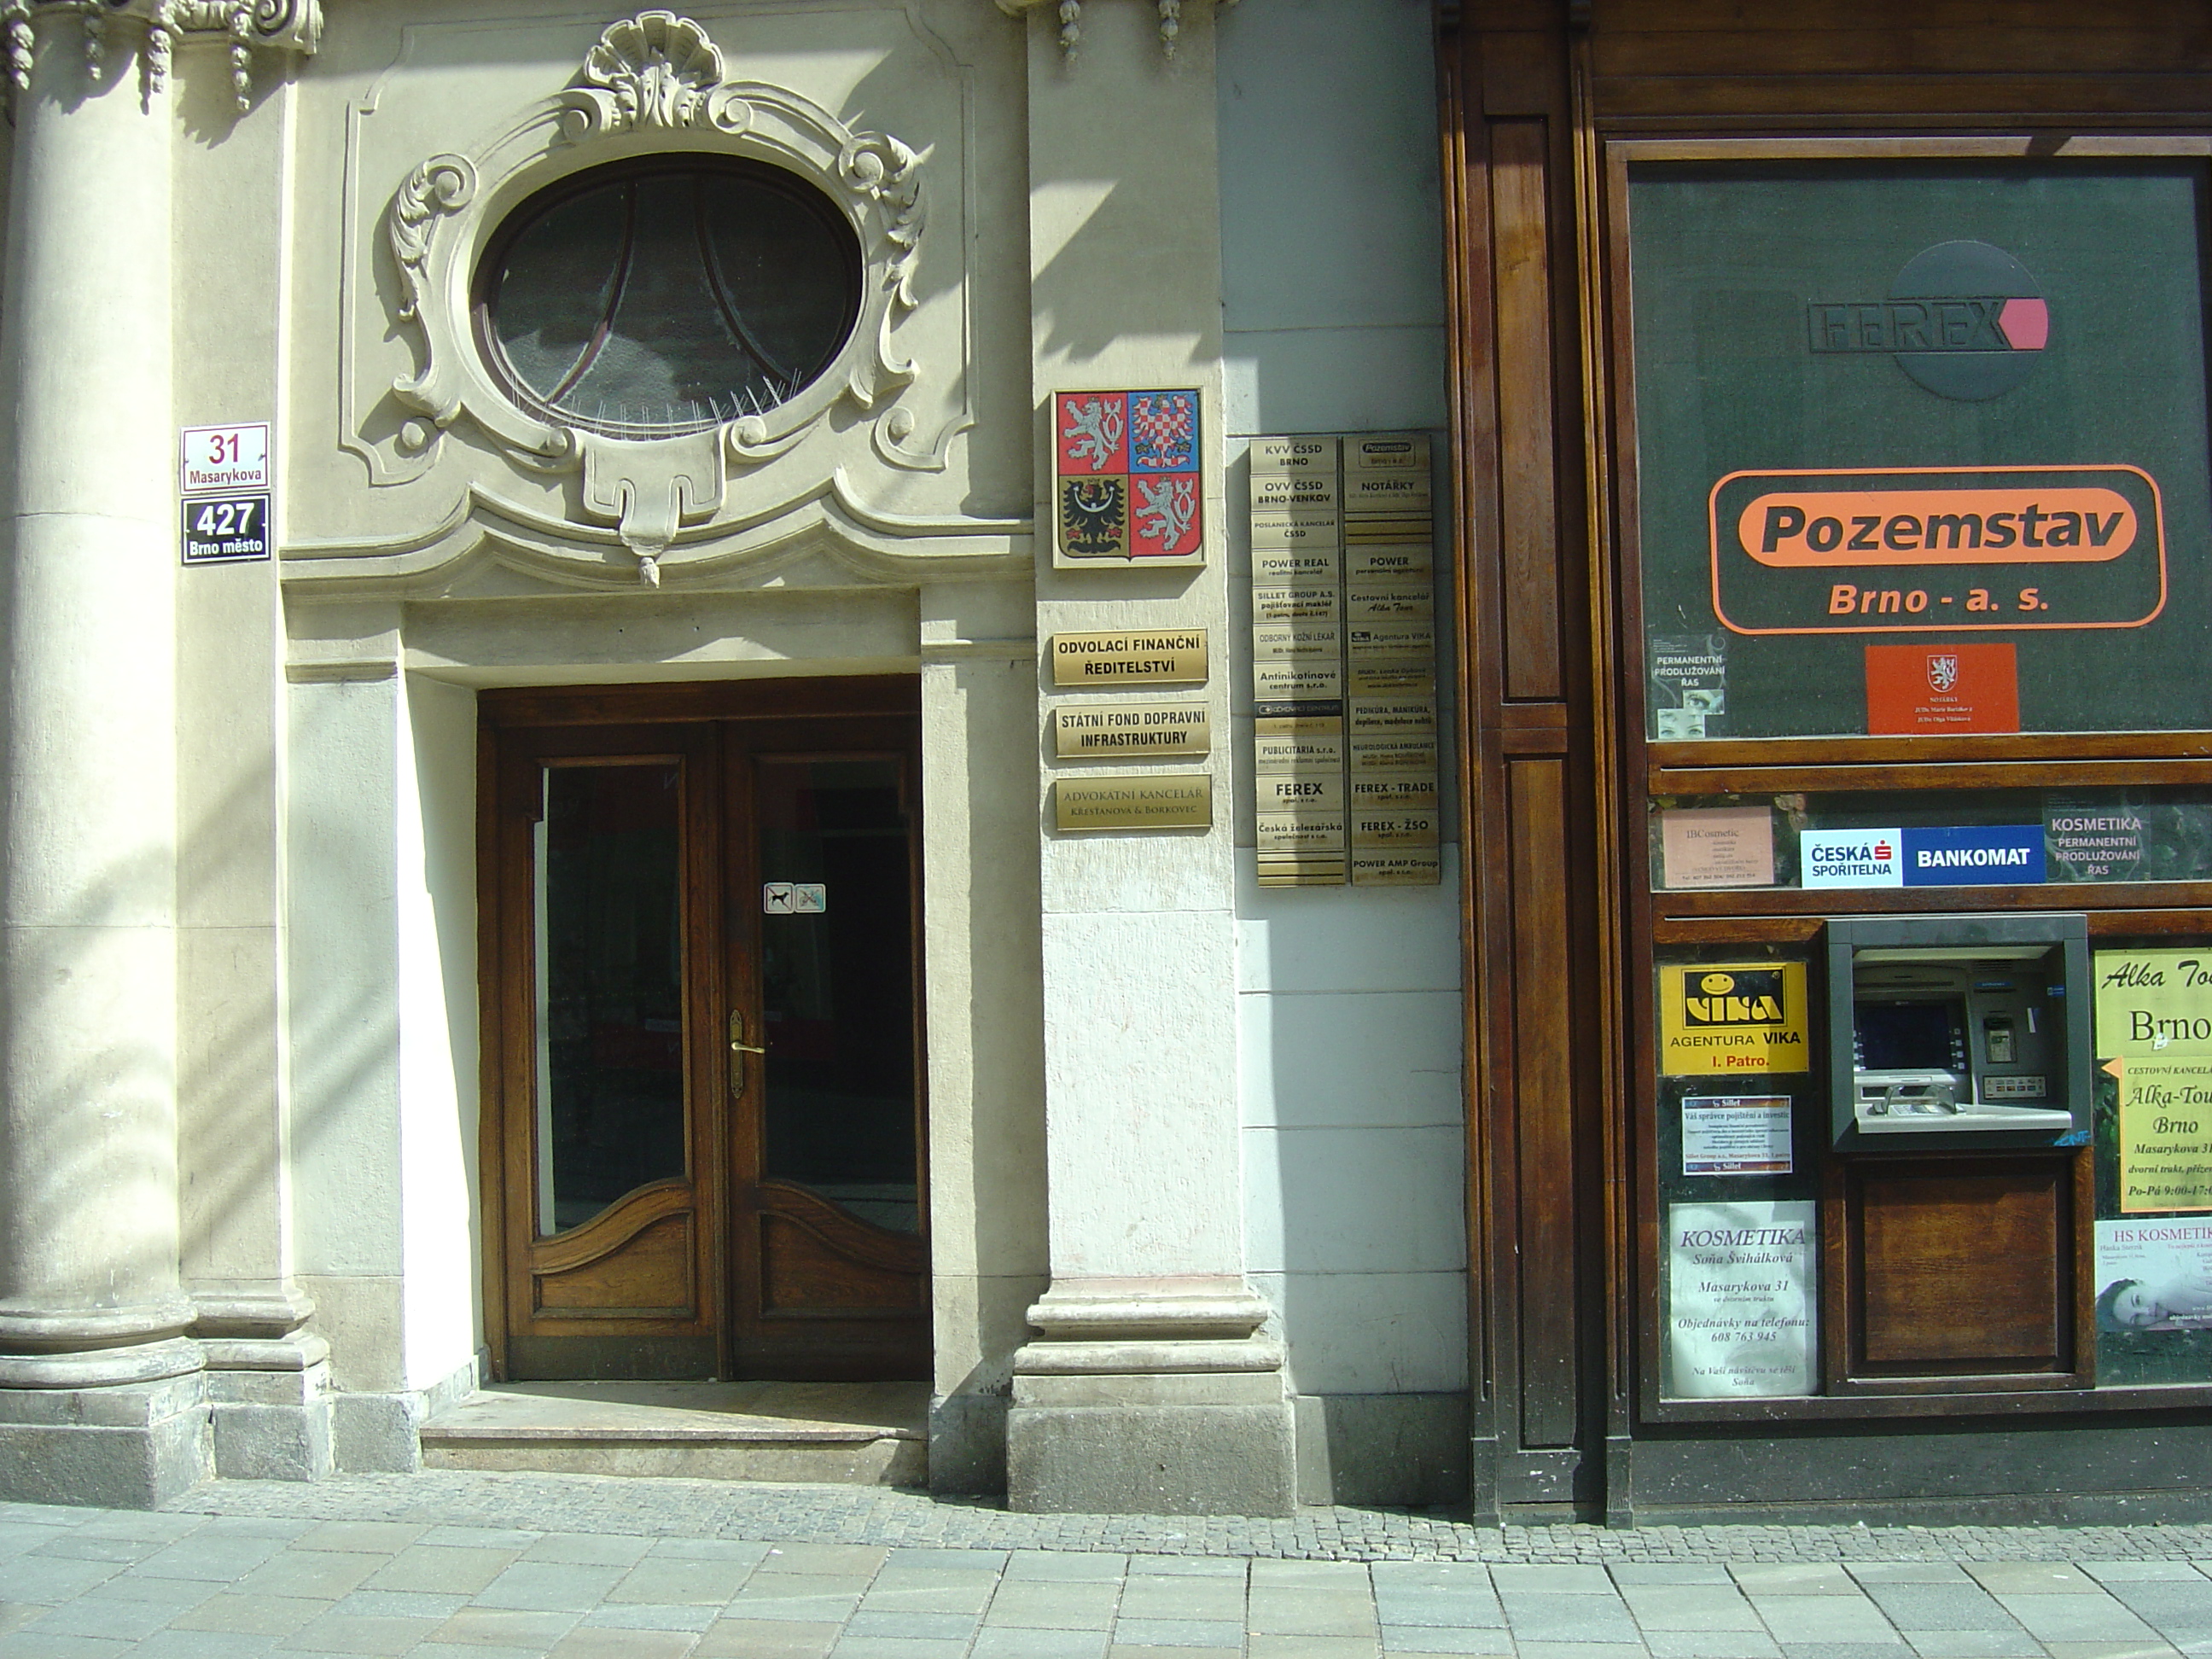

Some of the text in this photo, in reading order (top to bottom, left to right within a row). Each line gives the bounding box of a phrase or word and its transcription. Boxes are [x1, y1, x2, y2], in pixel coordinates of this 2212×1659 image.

[1813, 299, 2011, 348] FEREX
[209, 434, 238, 464] 31
[1266, 443, 1322, 454] KVV ČSSD
[189, 469, 261, 485] Masarykova
[1265, 480, 1323, 491] OVV ČSSD
[1361, 479, 1414, 491] NOTÁŘKY
[1258, 494, 1330, 504] BRNO-VENKOV
[197, 503, 254, 536] 427
[1761, 504, 2125, 554] Pozemstav
[189, 538, 263, 556] Brno město
[1304, 558, 1329, 567] REAL
[1371, 557, 1408, 566] POWER
[1351, 592, 1429, 602] Cestovní kancelář
[1828, 585, 1929, 614] Brno
[1965, 587, 2000, 612] a.
[2017, 587, 2049, 611] s.
[1058, 634, 1201, 654] ODVOLACÍ FINANČNÍ
[1373, 633, 1409, 642] Agentura
[1085, 657, 1175, 675] ŘEDITELSTVÍ
[1657, 655, 1722, 665] PERMANENTNÍ
[1260, 671, 1336, 680] Antinikotinové
[1655, 666, 1725, 676] PRODLUŽOVÁNÍ
[1681, 678, 1699, 686] ŘAS
[1062, 707, 1206, 728] STÁTNÍ FOND DOPRAVNÍ
[1081, 731, 1187, 748] INFRASTRUKTURY
[1262, 746, 1314, 754] PUBLICITARIA
[1140, 787, 1203, 800] KANCELÁŘ
[1276, 783, 1324, 795] FEREX
[1355, 783, 1434, 793] FEREX TRADE
[1259, 823, 1342, 832] Česká železářská
[1361, 818, 1429, 831] FEREX ŽSO
[2052, 818, 2142, 831] KOSMETIKA
[2058, 835, 2136, 847] PERMANENTNÍ
[1811, 842, 1871, 862] ČESKÁ
[1918, 848, 2030, 867] BANKOMAT
[2055, 849, 2140, 862] PRODLUŽOVÁNÍ
[1411, 859, 1438, 868] Group
[1812, 861, 1892, 876] SPOŘITELNA
[2087, 863, 2109, 876] ŘAS
[2101, 962, 2166, 989] Alka
[2129, 1010, 2211, 1040] Brno
[1671, 1032, 1801, 1047] AGENTURA VIKA
[1726, 1056, 1770, 1067] Patro.
[2128, 1066, 2171, 1075] CESTOVNÍ
[1722, 1098, 1740, 1107] Sillet
[1699, 1113, 1725, 1121] správce
[2153, 1116, 2198, 1134] Brno
[2134, 1144, 2198, 1156] Masarykova
[2128, 1164, 2159, 1173] dvorní
[2128, 1185, 2161, 1196] Po-Pá
[1680, 1228, 1806, 1247] KOSMETIKA
[2114, 1227, 2212, 1242] HS KOSMETIK
[1692, 1251, 1793, 1265] Soňa Švihálková
[1698, 1281, 1789, 1295] Masarykova 31
[1678, 1318, 1742, 1330] Objednávky
[1761, 1317, 1809, 1328] telefonu:
[1711, 1331, 1777, 1342] 608 763 945
[1692, 1367, 1705, 1376] Na
